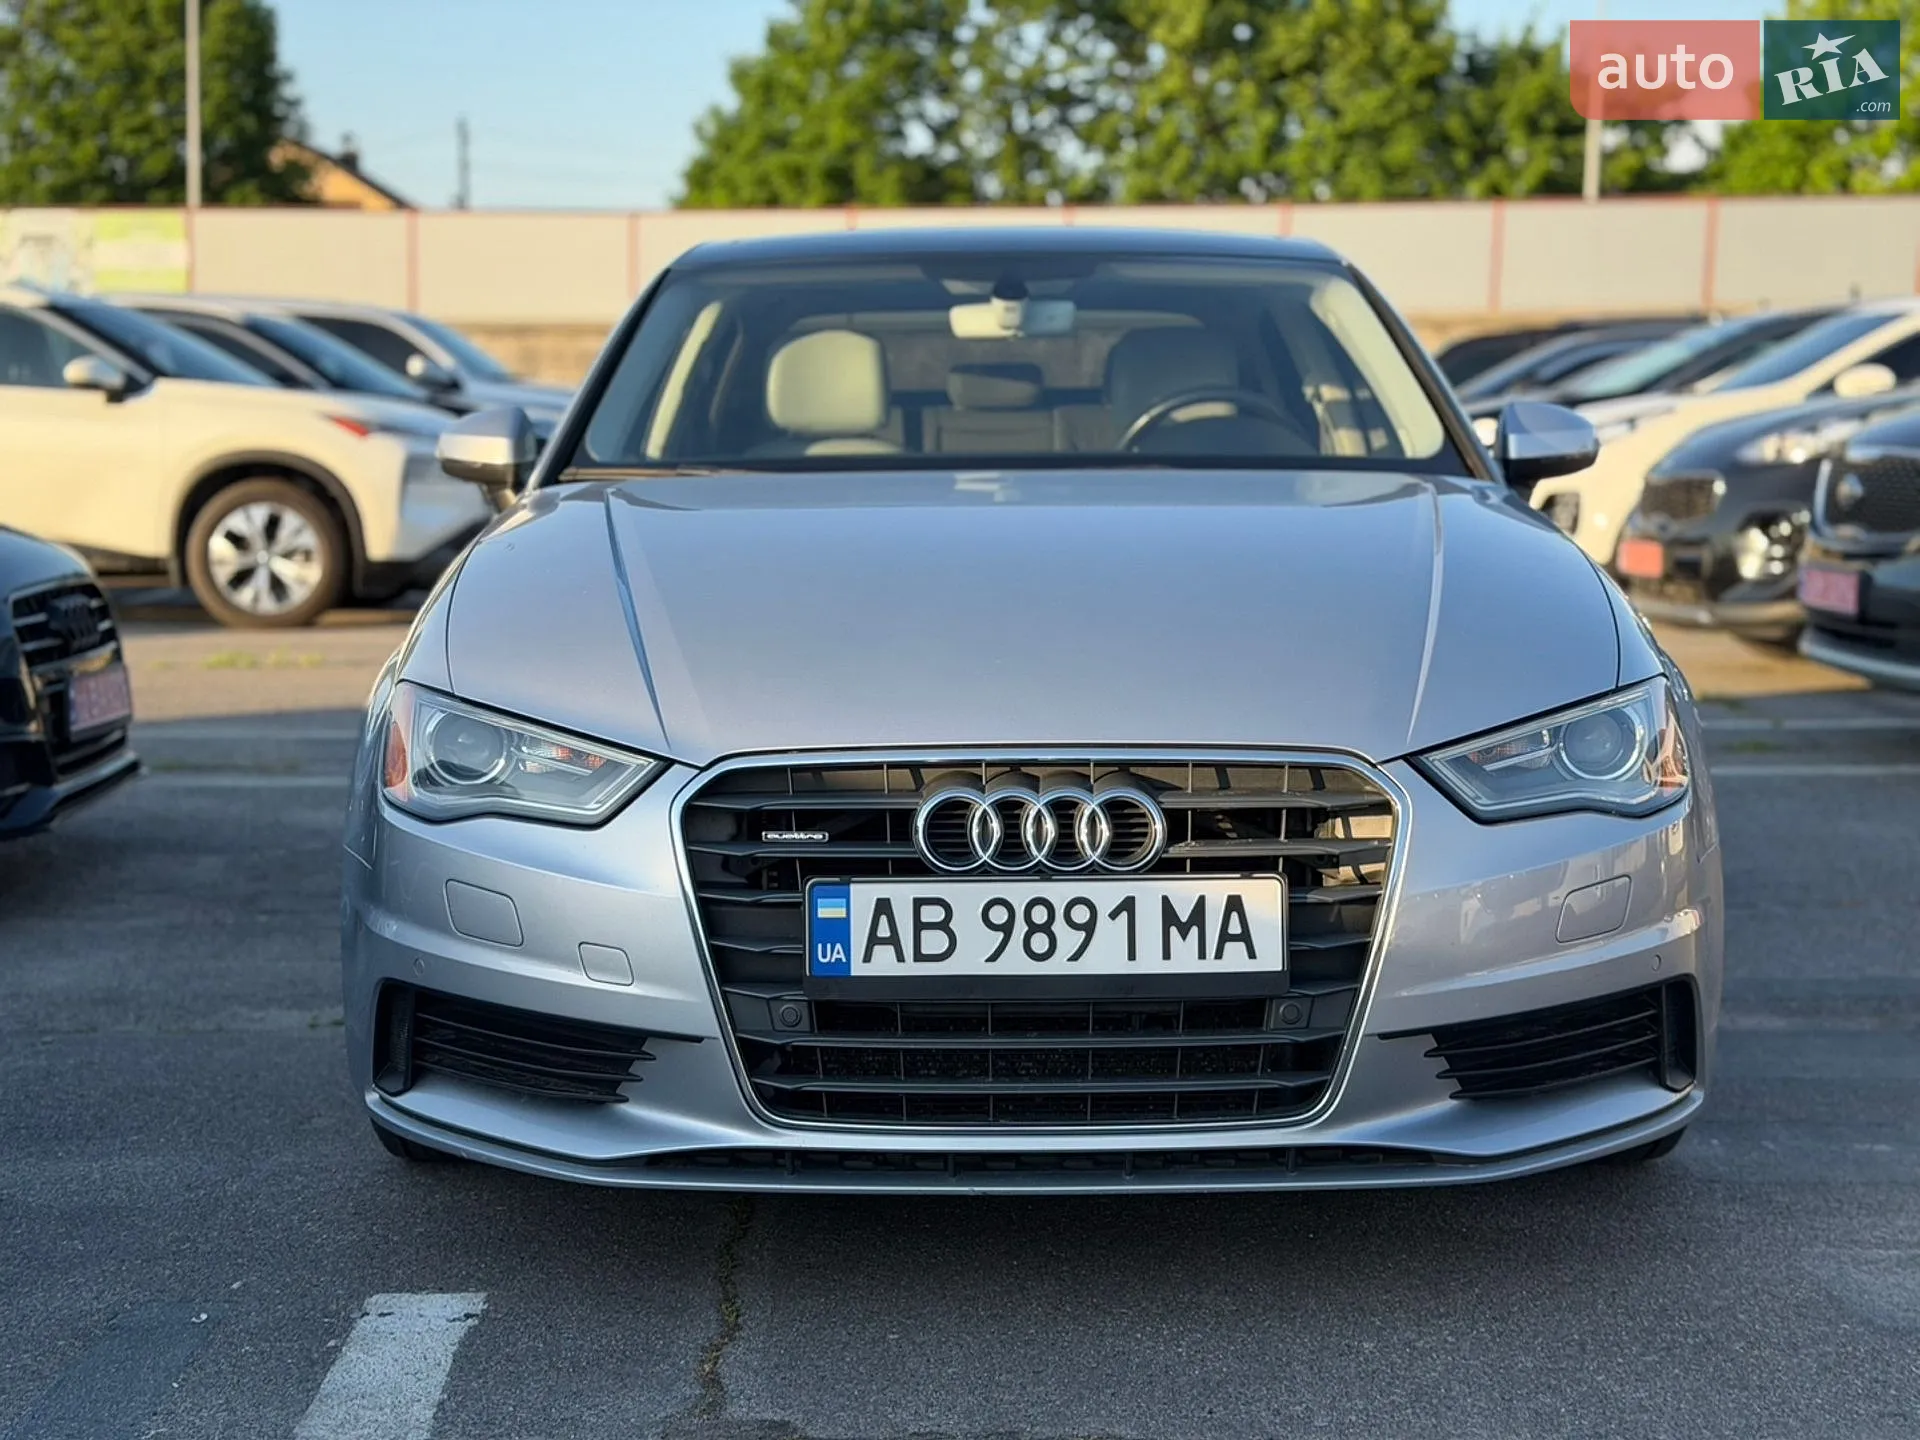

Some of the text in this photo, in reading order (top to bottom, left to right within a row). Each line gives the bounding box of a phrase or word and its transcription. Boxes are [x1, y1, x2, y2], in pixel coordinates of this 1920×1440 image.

[861, 894, 1258, 963] AB 9891 MA
[817, 943, 847, 963] UA
